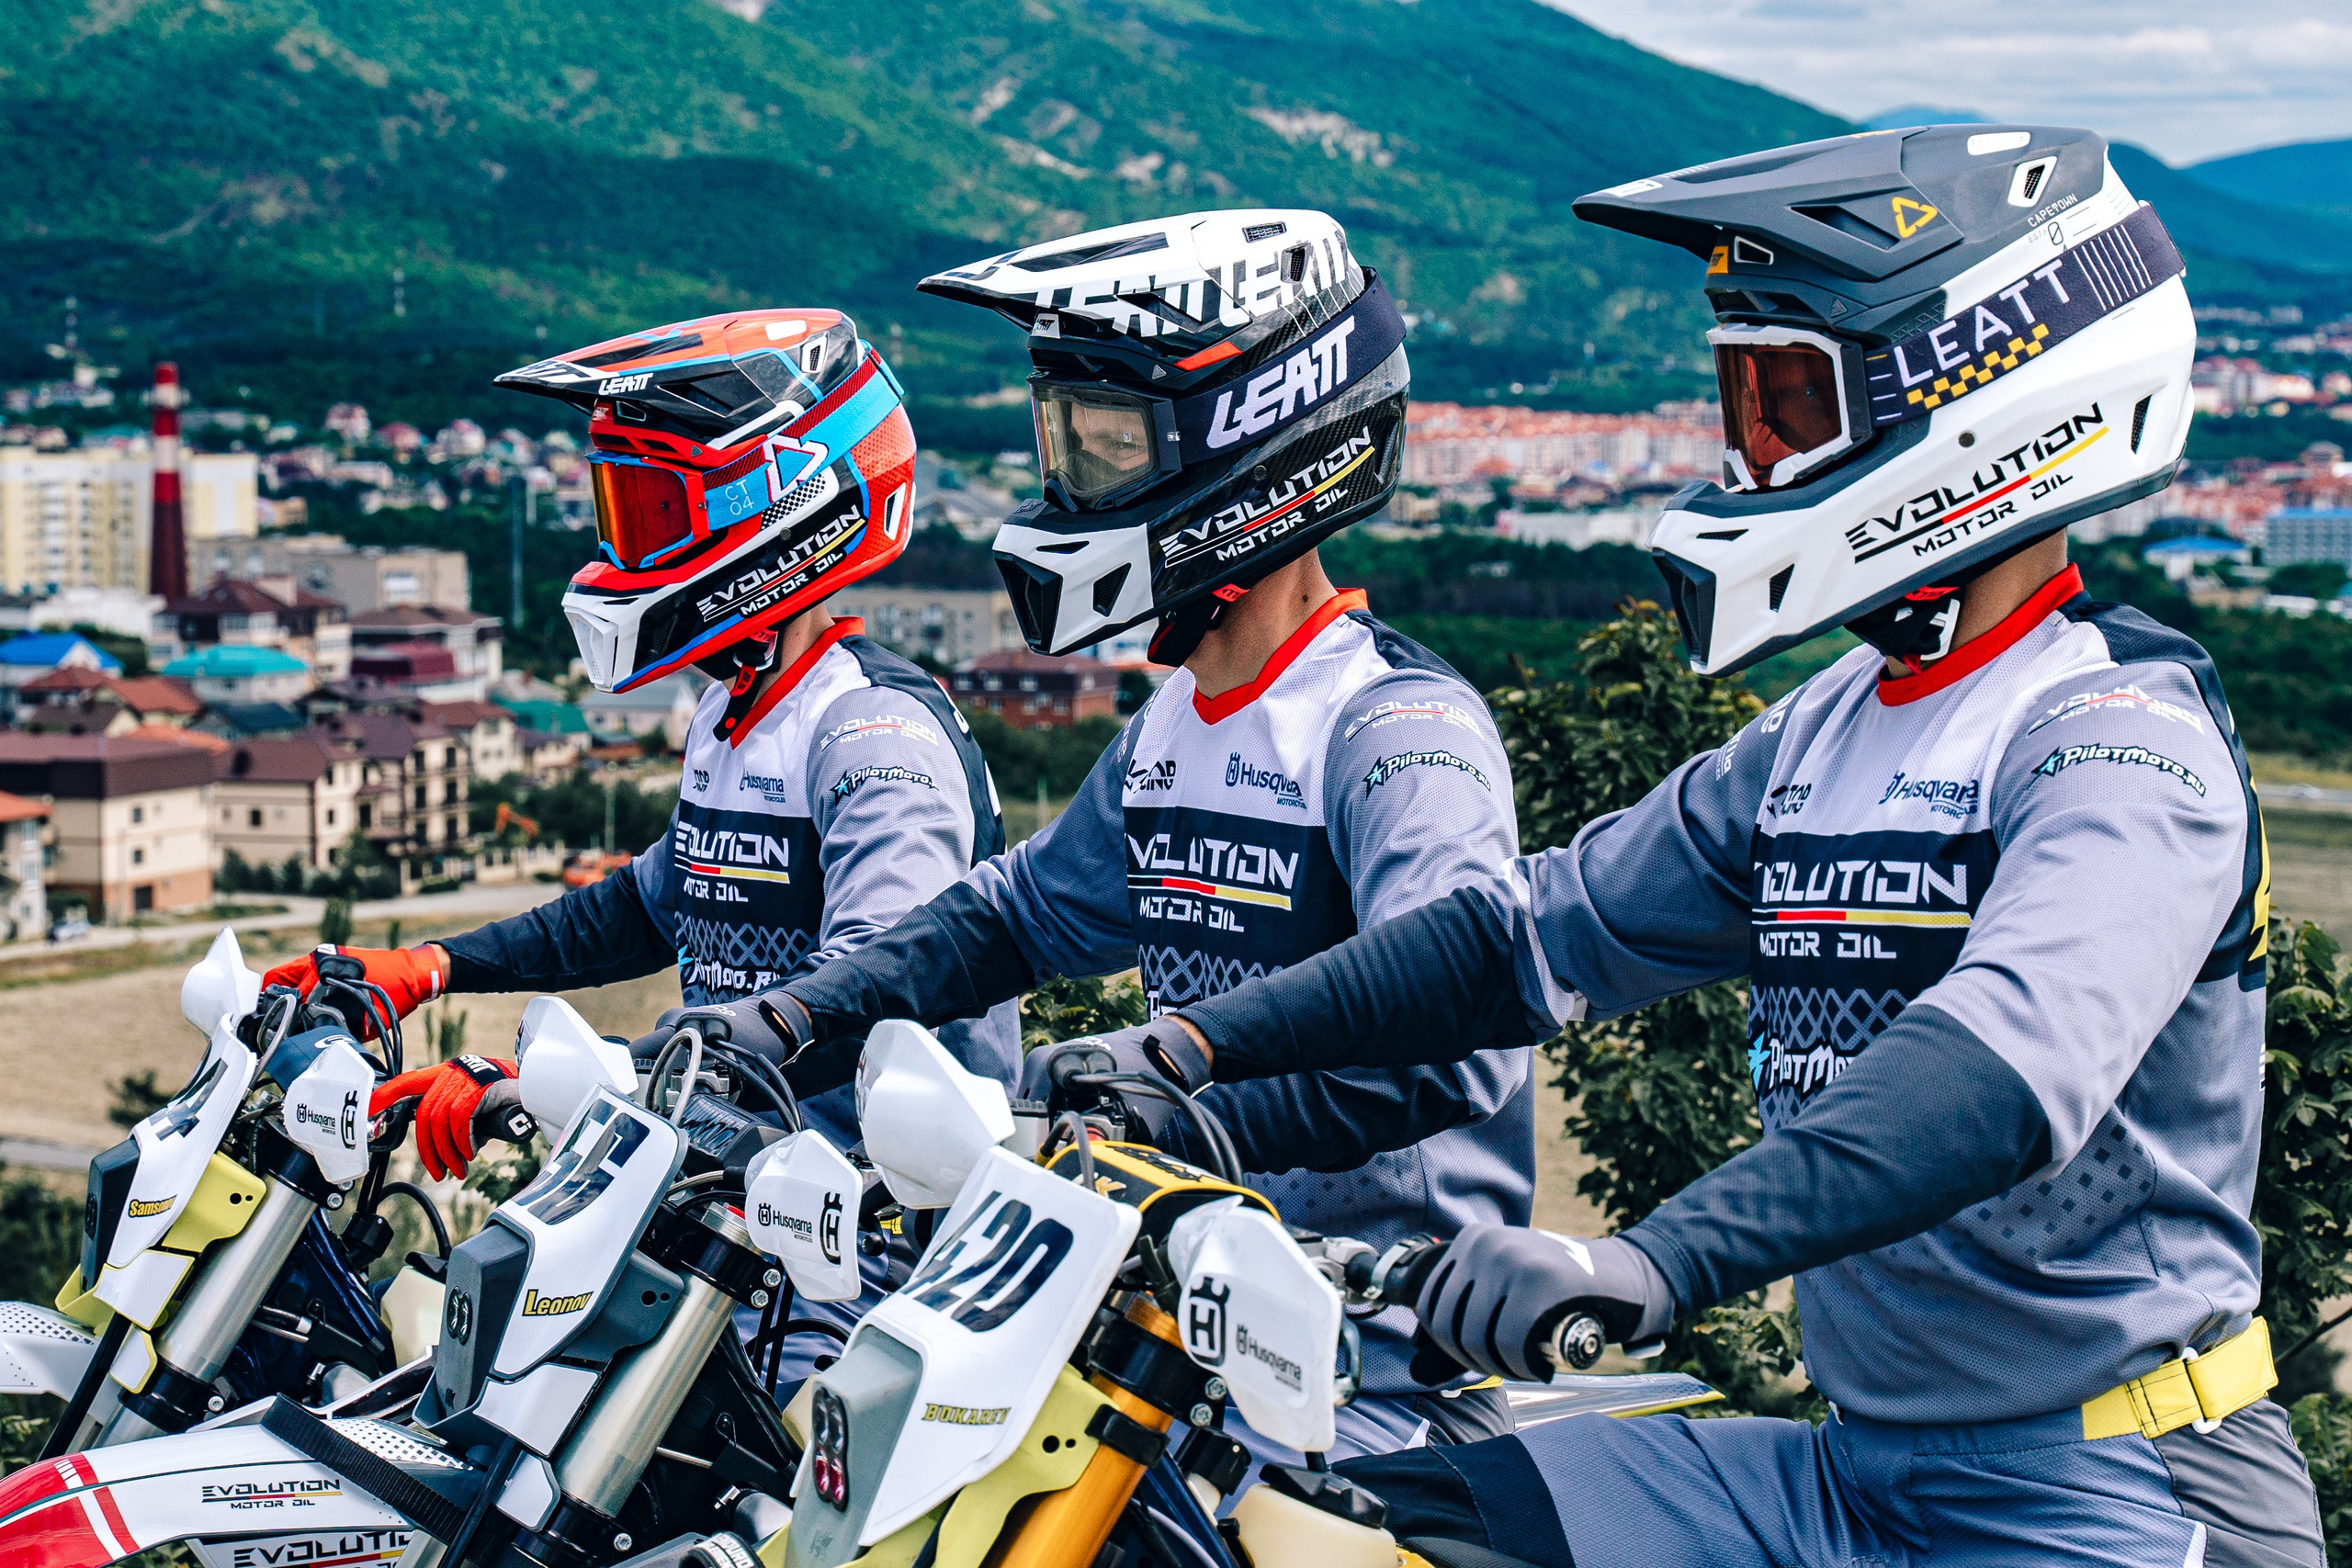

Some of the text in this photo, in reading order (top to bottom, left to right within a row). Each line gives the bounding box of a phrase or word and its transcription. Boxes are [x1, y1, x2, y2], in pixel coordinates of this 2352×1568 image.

[2027, 193, 2078, 227] CAPETOWN
[1894, 258, 2071, 388] LEATT
[598, 373, 653, 396] LEATT
[1206, 314, 1356, 450] LEATT
[725, 479, 748, 501] CT
[1845, 401, 2104, 551] EVOLUTION
[729, 496, 754, 515] 04
[1159, 425, 1372, 558] EVOLUTION
[1215, 488, 1348, 561] MOTOR OIL
[1912, 474, 2074, 558] MOTOR OIL
[695, 504, 862, 616] EVOLUTION
[740, 551, 843, 615] MOTOR OIL
[1372, 714, 1466, 730] MOTOR OIL
[2060, 698, 2177, 723] MOTOR OIL
[840, 728, 922, 744] MOTOR OIL
[675, 820, 789, 867] EOLUTION
[1125, 832, 1299, 889] VOLUTION
[715, 882, 749, 902] OIL
[1208, 904, 1245, 933] OIL
[1759, 931, 1897, 959] MOTOR OIL
[773, 1209, 813, 1234] Husqvarna
[522, 1288, 594, 1317] Leonov
[202, 1479, 341, 1497] EVOLUTION
[231, 1498, 316, 1510] MOTOR OIL
